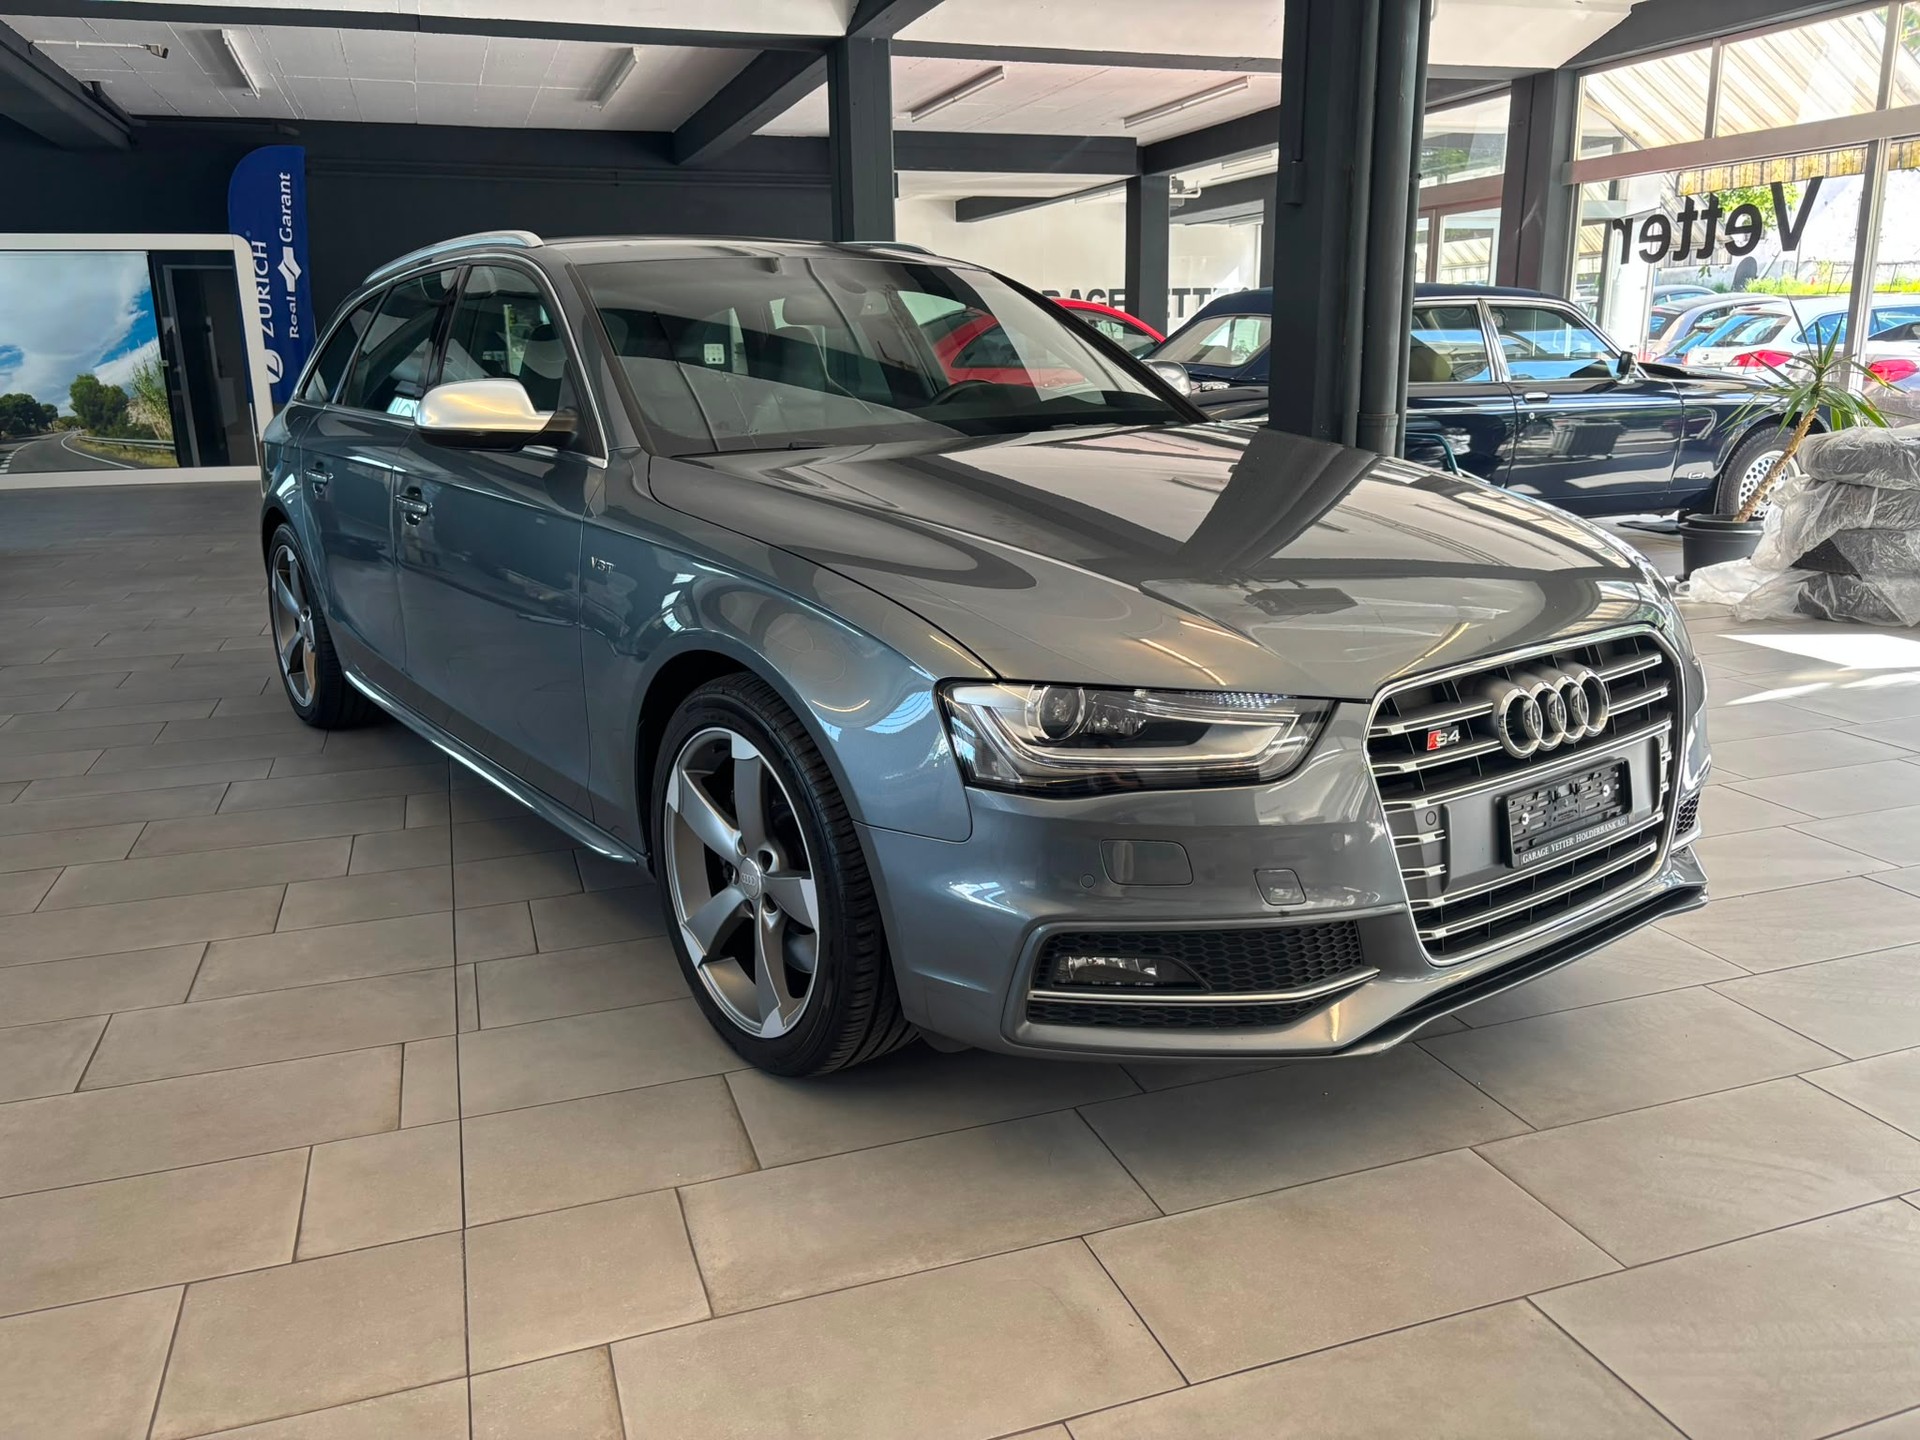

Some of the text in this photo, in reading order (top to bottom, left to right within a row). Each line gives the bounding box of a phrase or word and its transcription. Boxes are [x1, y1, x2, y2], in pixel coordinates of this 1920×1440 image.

[279, 172, 300, 338] Real Garant
[251, 241, 275, 338] ZURICH
[1433, 730, 1461, 747] S4
[1522, 847, 1550, 864] GARAGE
[1551, 837, 1575, 853] VETTER
